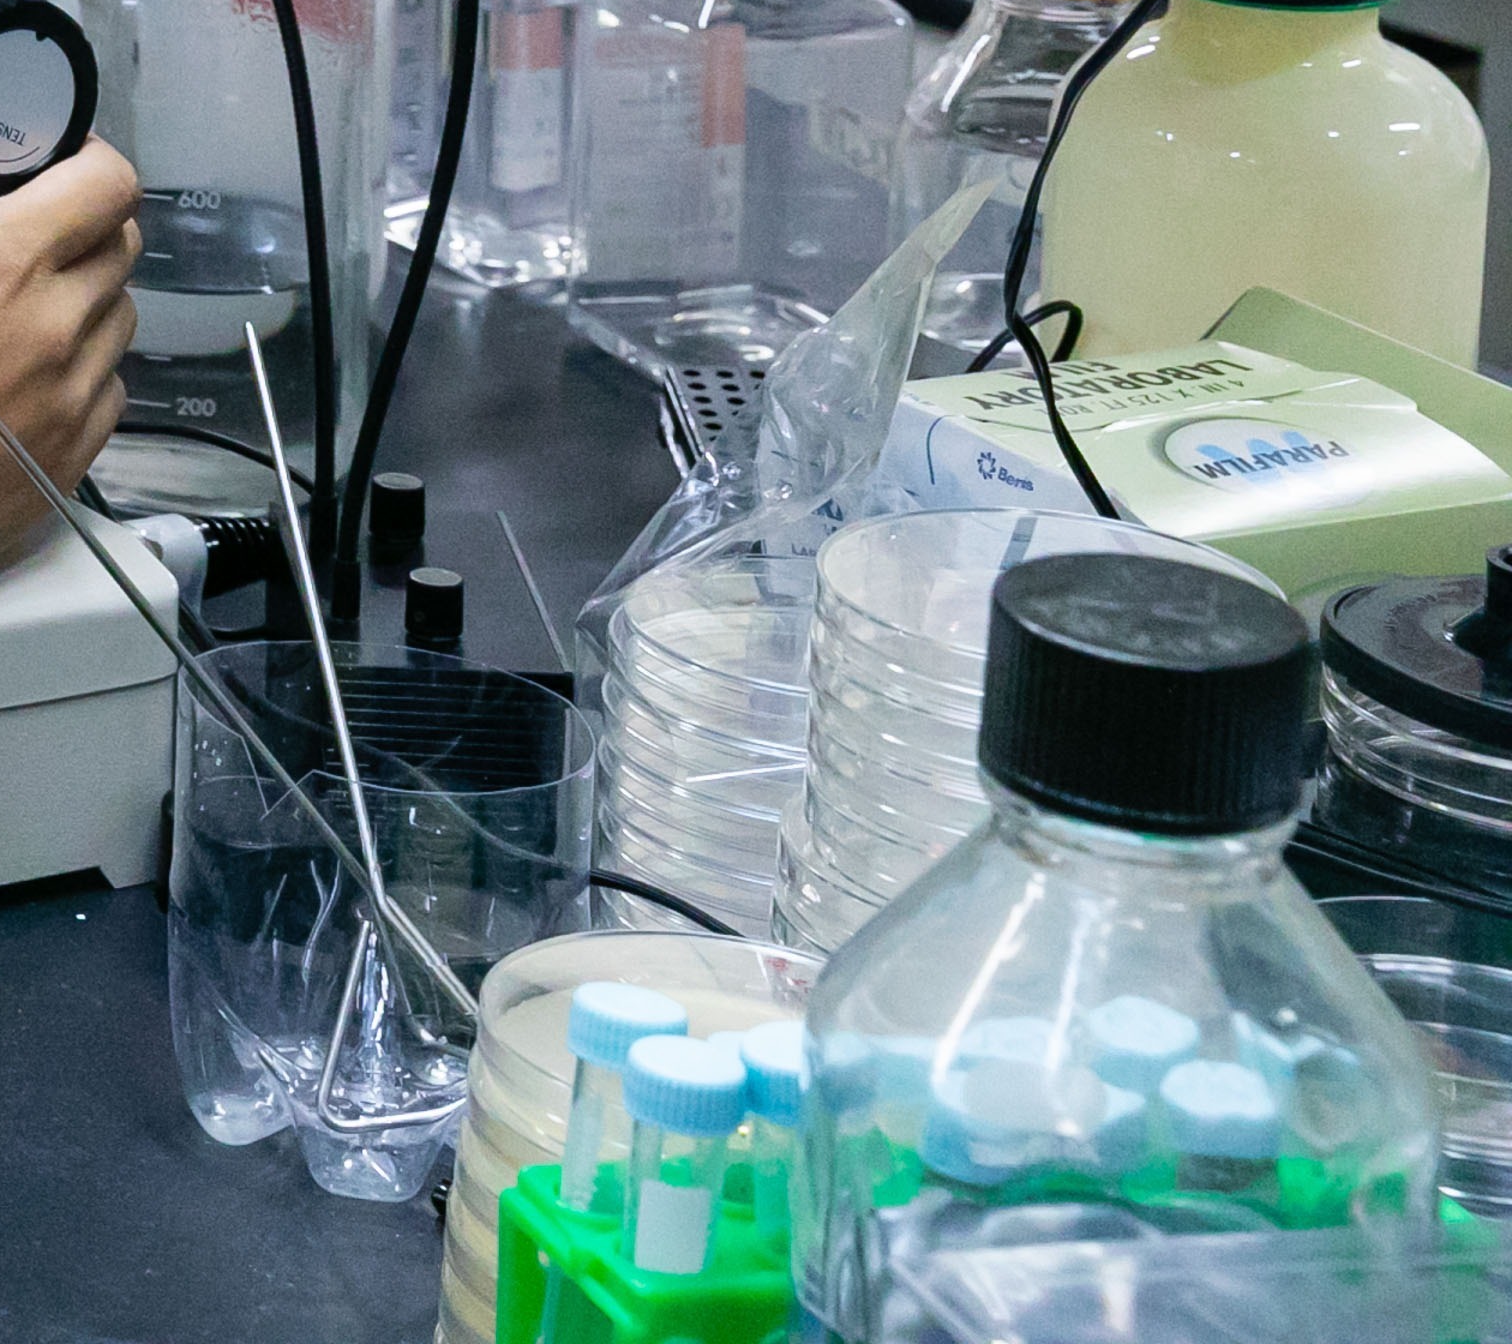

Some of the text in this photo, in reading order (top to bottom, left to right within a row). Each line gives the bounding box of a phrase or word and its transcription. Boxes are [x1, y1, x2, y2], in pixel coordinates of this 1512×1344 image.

[177, 190, 221, 210] 600
[962, 358, 1255, 411] LABORATORY
[176, 397, 217, 418] 200
[1128, 392, 1174, 406] 125
[1192, 440, 1351, 480] PARAFILM
